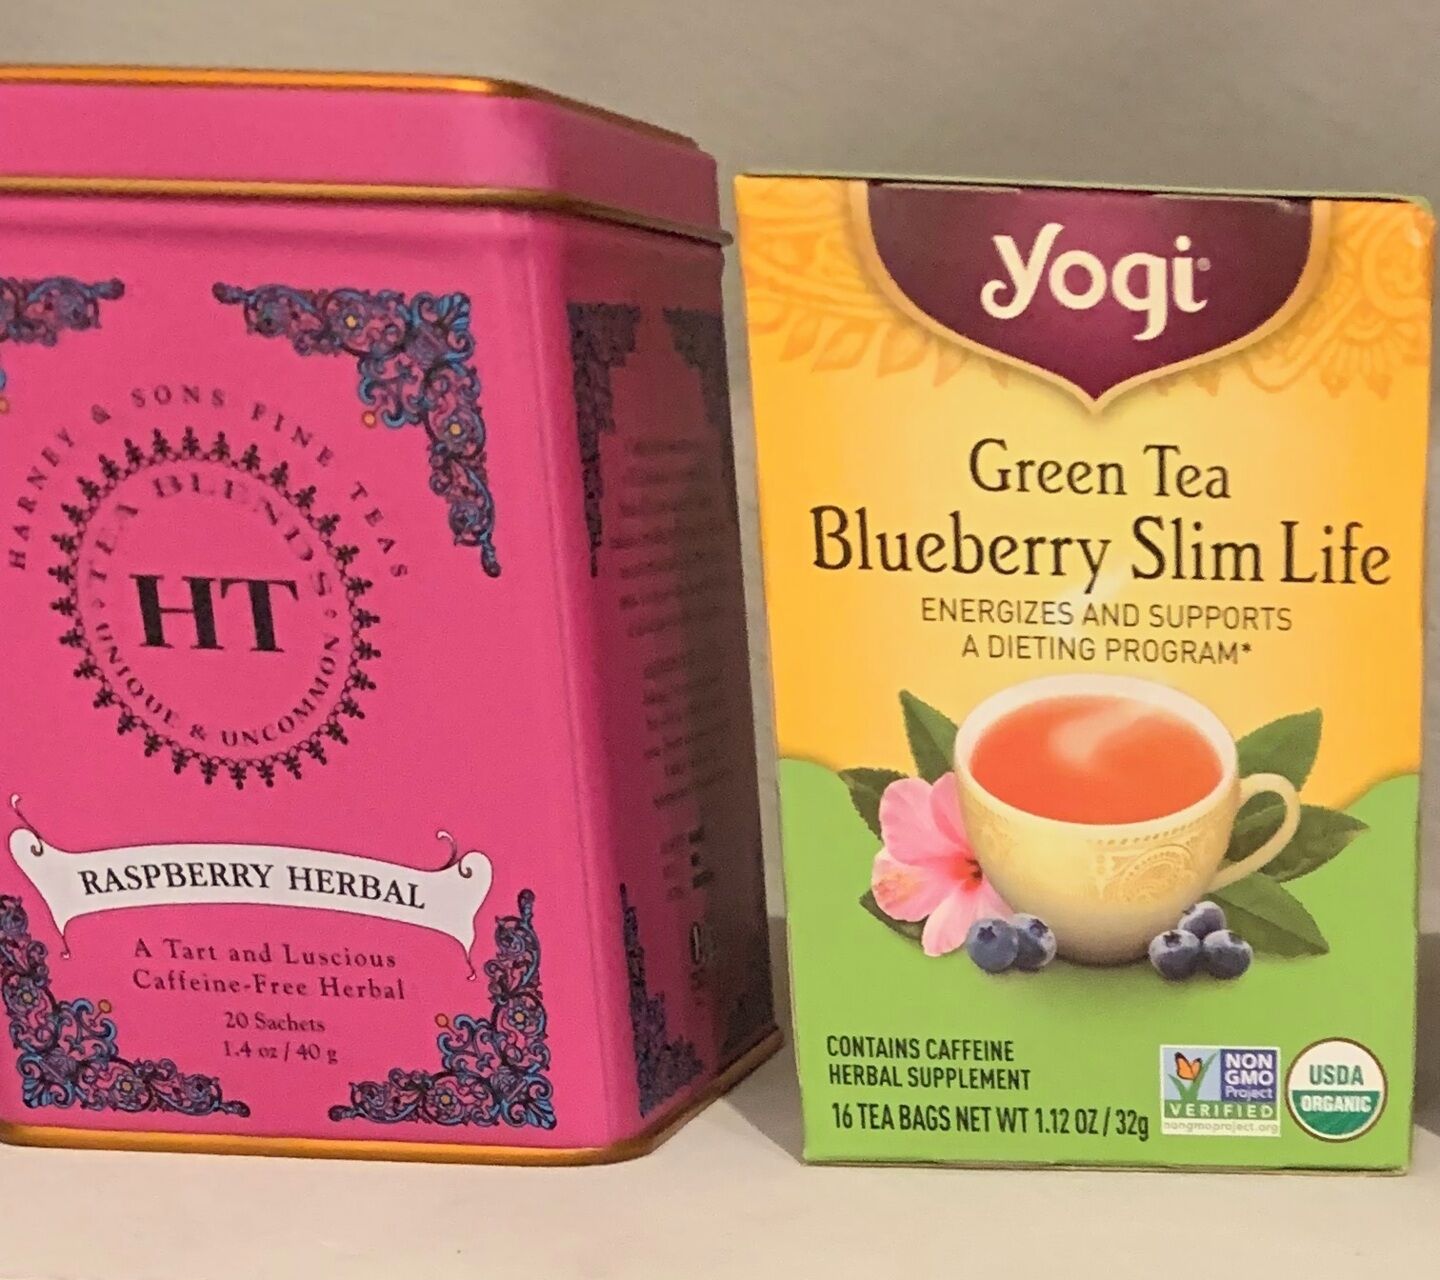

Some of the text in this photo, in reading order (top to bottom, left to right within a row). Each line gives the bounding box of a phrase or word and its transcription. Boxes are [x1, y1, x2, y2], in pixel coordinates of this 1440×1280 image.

[8, 427, 75, 570] HARNEY
[131, 385, 225, 407] SONS
[251, 402, 334, 467] FINE
[351, 481, 408, 577] TEAS
[969, 438, 1231, 498] Green Tea
[809, 504, 1392, 594] Blueberry Slim Life
[129, 574, 299, 653] HT
[921, 596, 1293, 631] ENERGIZES AND SUPPORTS
[961, 634, 979, 658] A
[988, 635, 1096, 661] DIETING
[95, 622, 180, 725] UNIQUE
[220, 636, 340, 746] UNCOMMON
[78, 862, 426, 910] RASPBERRY HERBAL
[134, 938, 397, 968] A Tart and Luscious
[132, 968, 405, 1000] Caffeine-Free Herbal
[224, 1011, 326, 1033] 20 Sachets
[223, 1041, 251, 1059] 1.4
[258, 1046, 278, 1060] oz
[295, 1042, 321, 1061] 40
[327, 1047, 338, 1064] g
[826, 1035, 1015, 1062] CONTAINS CAFFEINE
[1225, 1053, 1273, 1070] NON
[829, 1063, 1031, 1090] HERBAL SUPPLEMENT
[1224, 1070, 1274, 1086] GMO
[1309, 1064, 1364, 1085] USDA
[1225, 1086, 1273, 1100] Project
[1301, 1095, 1372, 1113] ORGANIC
[832, 1102, 853, 1128] 16
[857, 1103, 895, 1130] TEA
[899, 1104, 951, 1131] BAGS
[956, 1106, 992, 1132] NET
[996, 1106, 1031, 1133] WT
[1034, 1108, 1070, 1134] 1.12
[1075, 1108, 1099, 1135] OZ
[1115, 1110, 1149, 1142] 32g
[1170, 1103, 1274, 1118] VERIFIED
